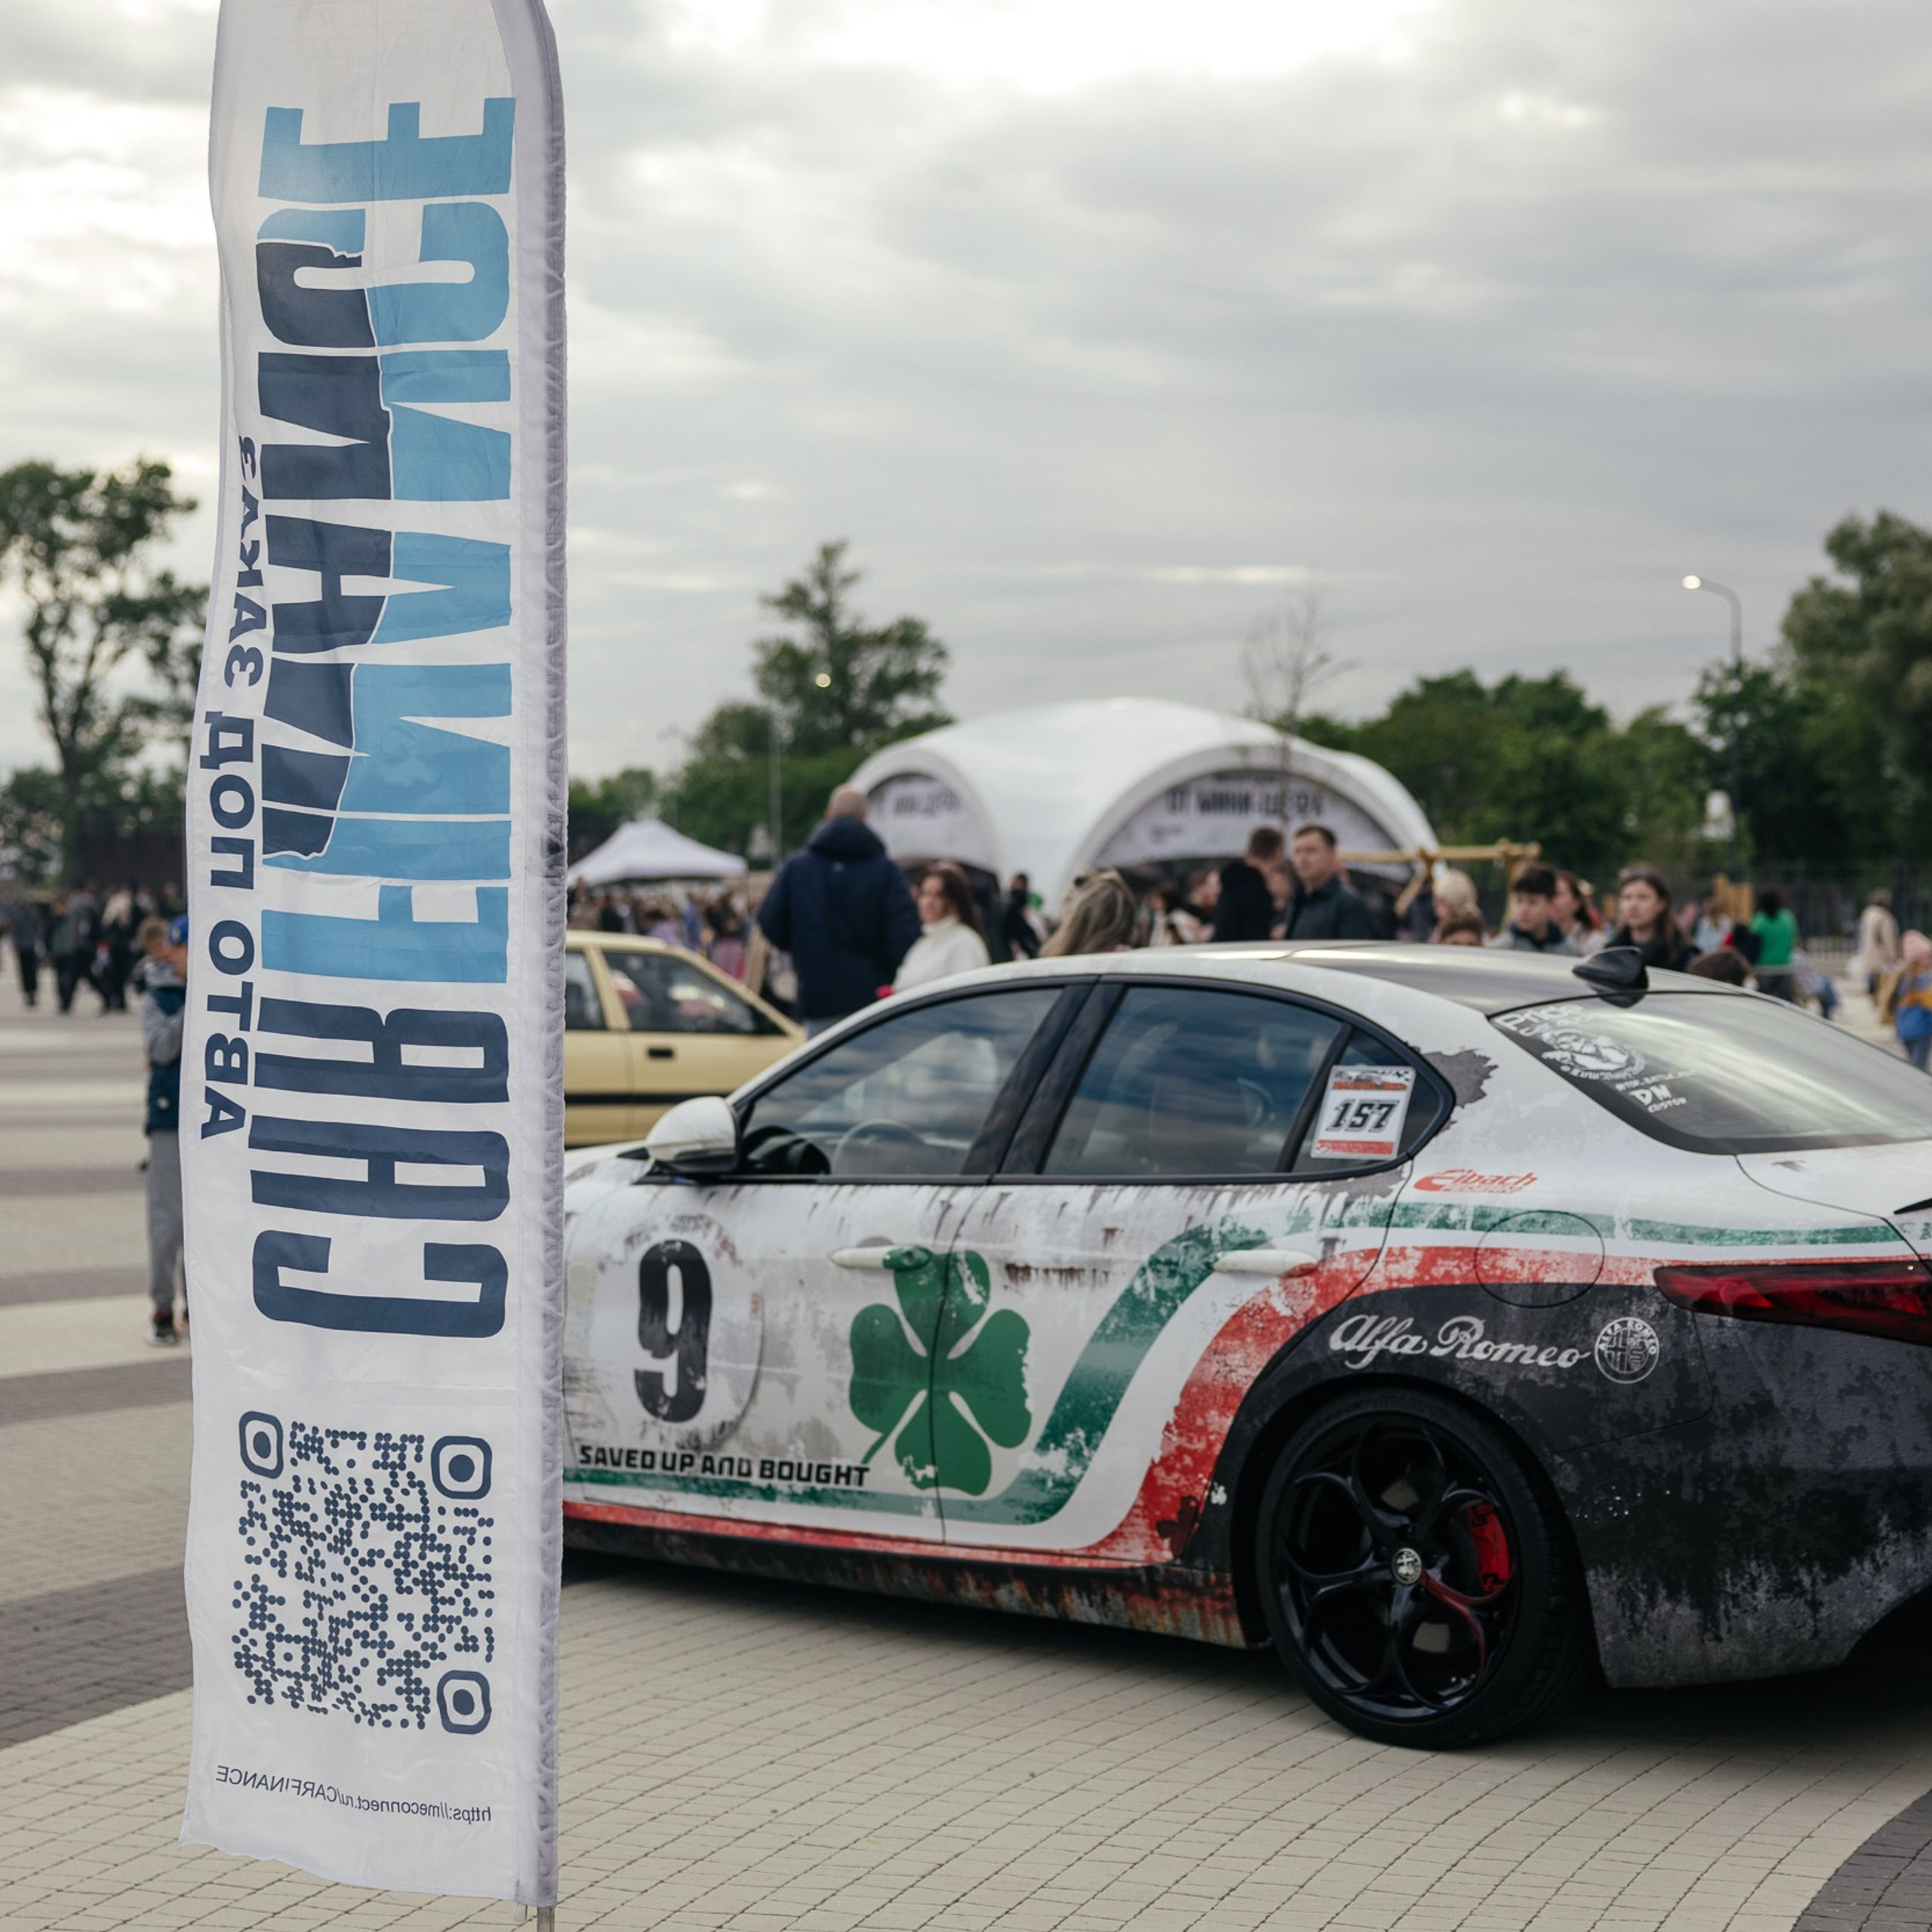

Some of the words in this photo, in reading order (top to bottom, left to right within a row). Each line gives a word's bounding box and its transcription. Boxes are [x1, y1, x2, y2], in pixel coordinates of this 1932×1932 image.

[1325, 1098, 1401, 1132] 157
[1414, 1169, 1537, 1191] Eibach
[633, 1238, 712, 1424] 9
[1328, 1314, 1428, 1369] Alfa
[1429, 1315, 1590, 1368] Romeo
[1598, 1322, 1622, 1352] ALFA
[1627, 1319, 1657, 1355] ROMEO
[579, 1444, 656, 1470] SAVED
[661, 1452, 694, 1474] UP
[701, 1454, 752, 1478] AND
[759, 1459, 870, 1487] BOUGHT
